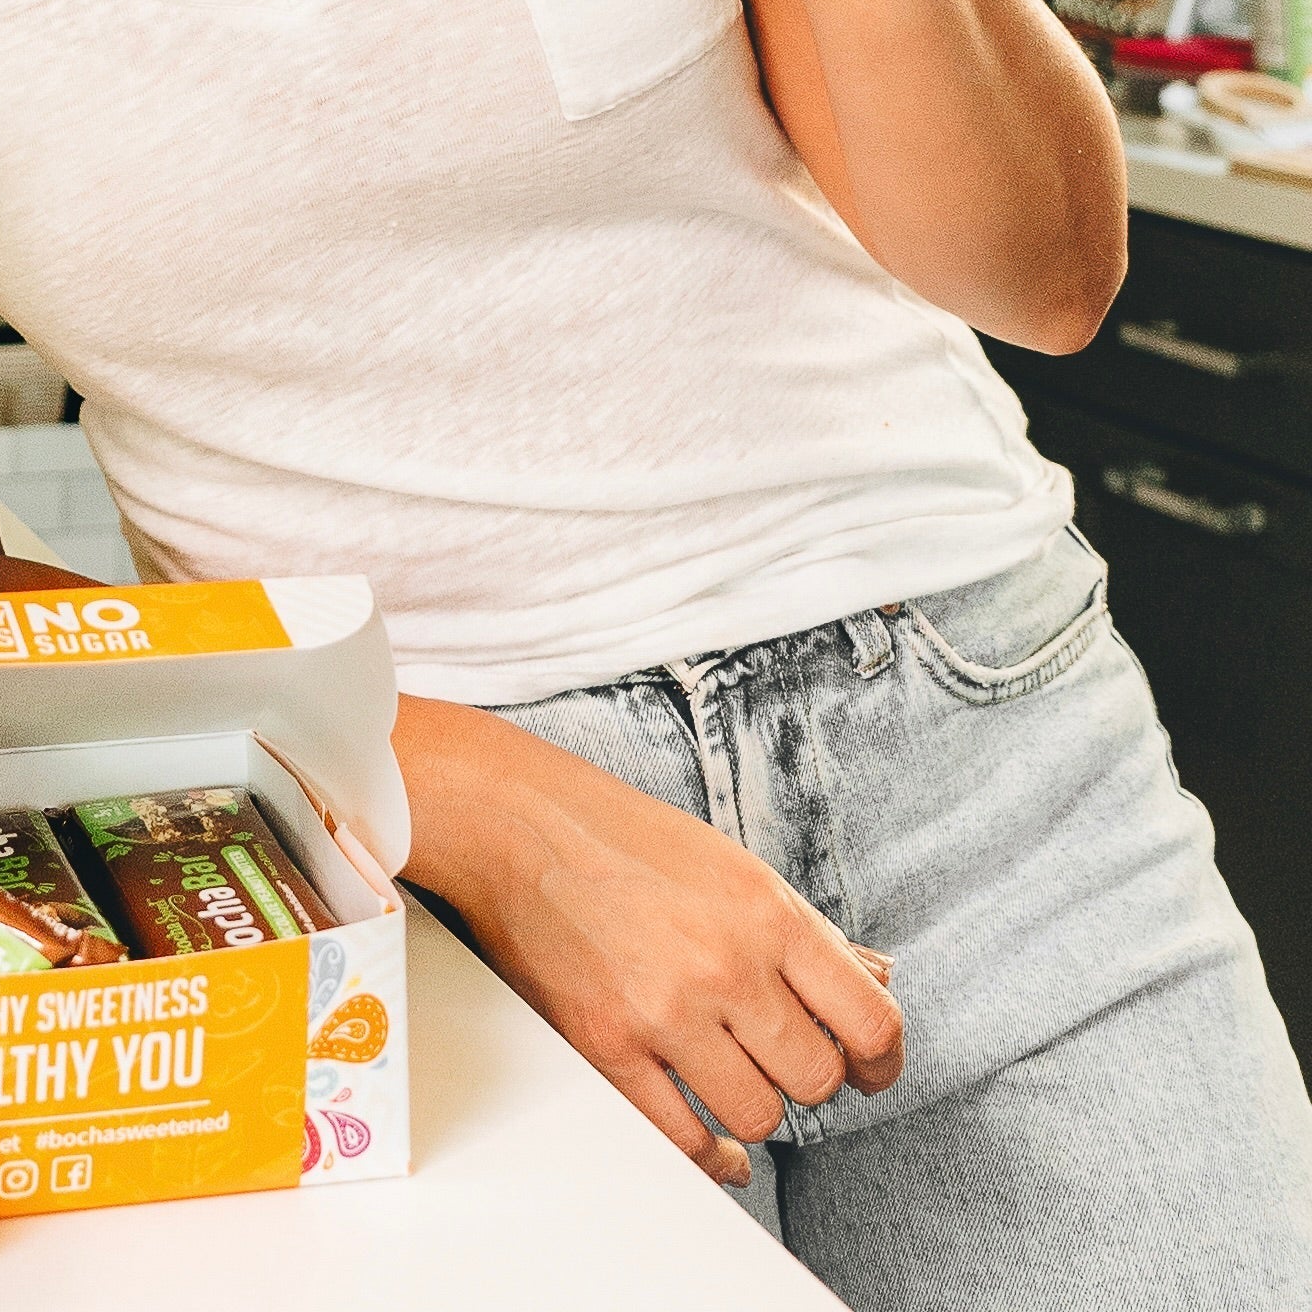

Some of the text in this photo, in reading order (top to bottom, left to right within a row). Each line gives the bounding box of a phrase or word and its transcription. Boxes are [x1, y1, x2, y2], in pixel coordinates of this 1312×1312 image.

[24, 598, 141, 637] NO
[36, 629, 152, 657] SUGAR
[174, 855, 264, 946] ochaBar
[36, 976, 209, 1034] SWEETNESS
[112, 1027, 205, 1095] YOU
[35, 1109, 230, 1151] #bochasweetened
